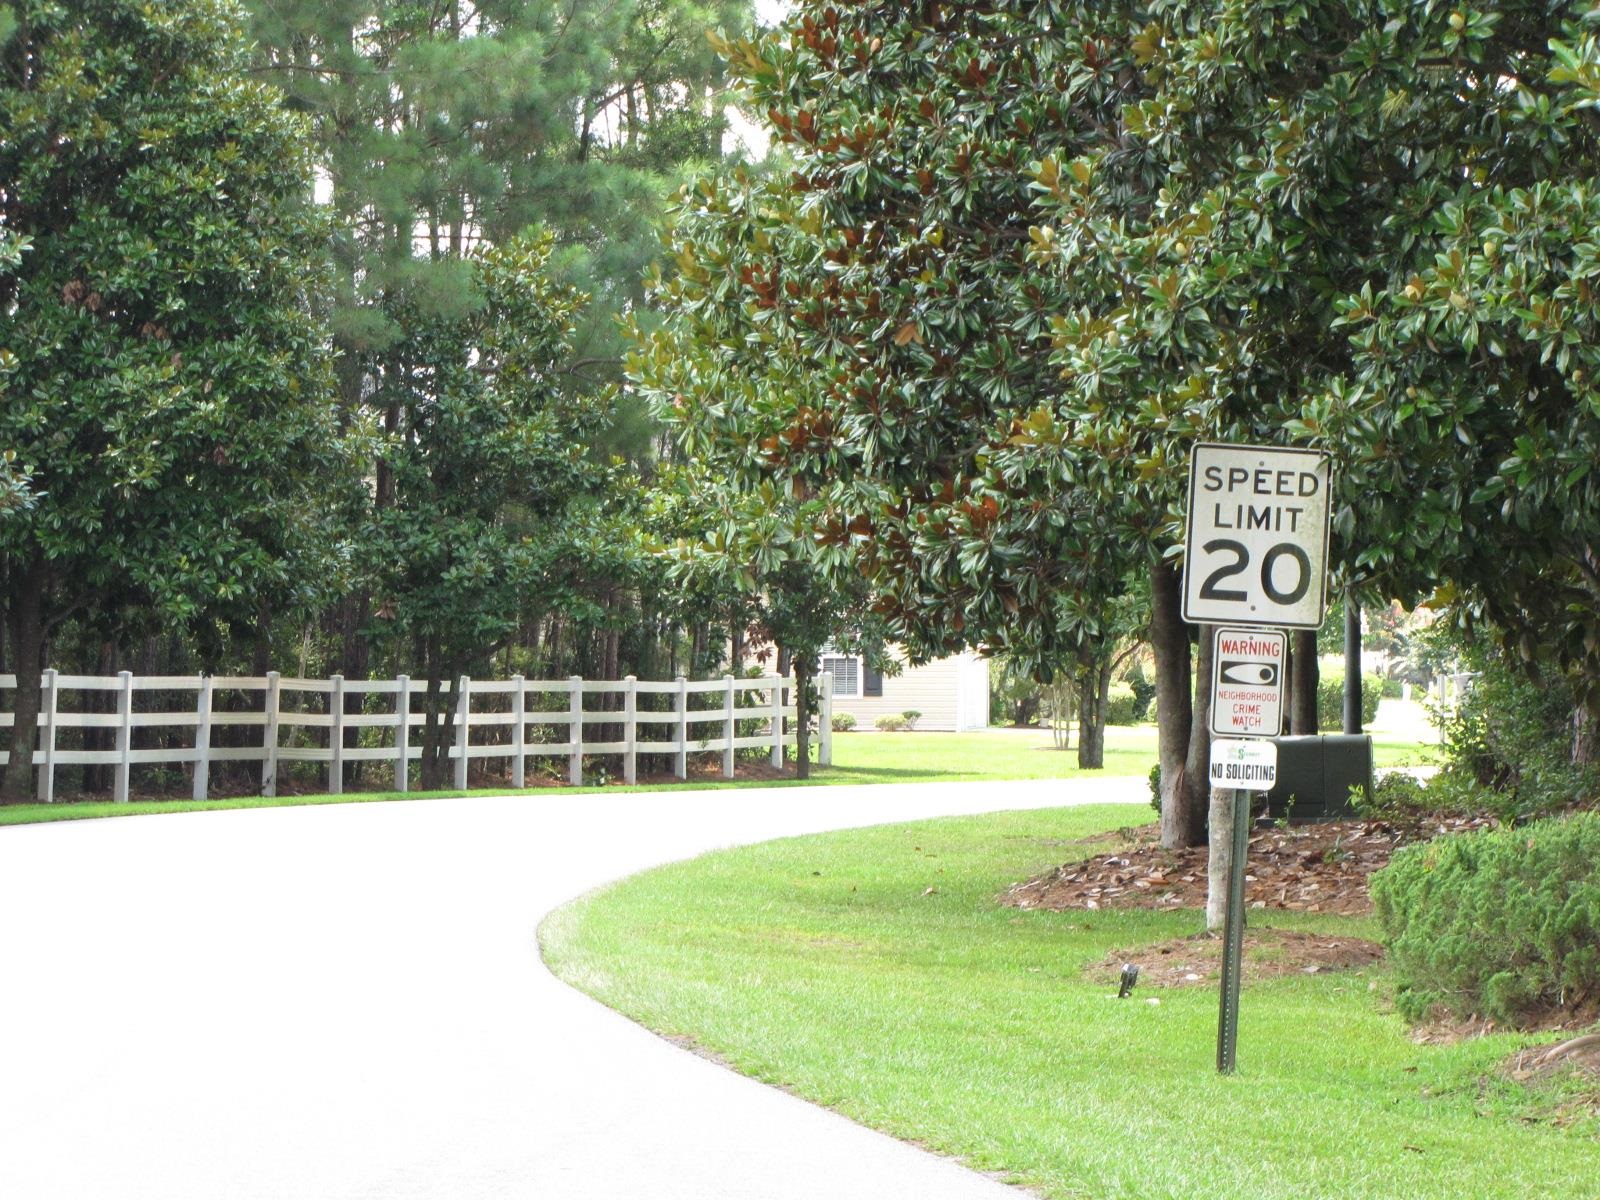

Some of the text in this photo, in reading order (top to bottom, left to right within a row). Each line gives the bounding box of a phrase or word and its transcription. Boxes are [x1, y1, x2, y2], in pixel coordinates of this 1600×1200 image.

[1203, 466, 1319, 497] SPEED
[1214, 503, 1303, 532] LIMIT
[1199, 538, 1311, 605] 20
[1221, 640, 1280, 657] WARNING
[1218, 691, 1277, 702] NEIGHBORHOOD
[1232, 704, 1261, 715] CRIME
[1232, 716, 1261, 727] WATCH
[1211, 762, 1274, 781] NO SOLICITING
